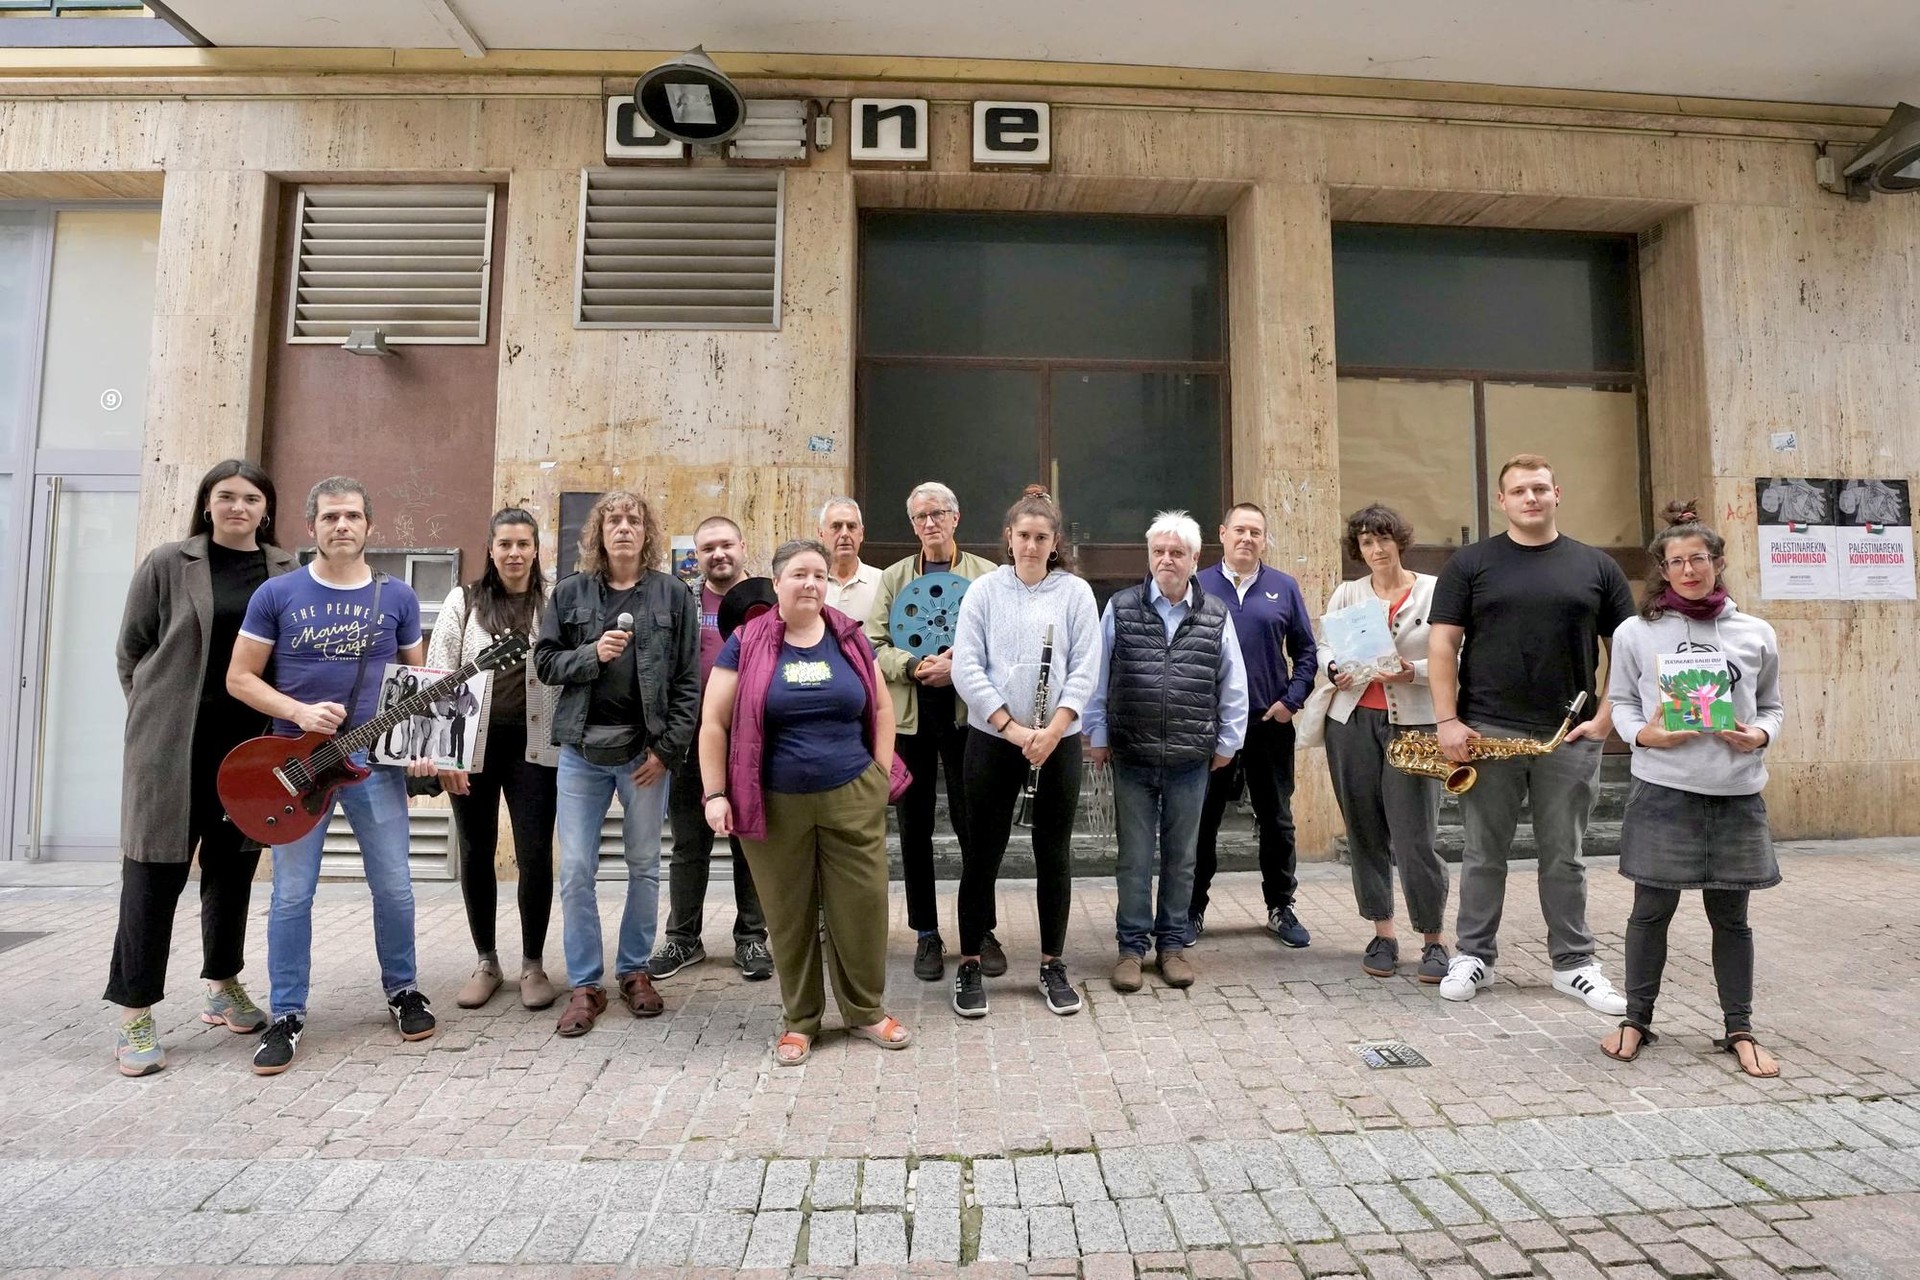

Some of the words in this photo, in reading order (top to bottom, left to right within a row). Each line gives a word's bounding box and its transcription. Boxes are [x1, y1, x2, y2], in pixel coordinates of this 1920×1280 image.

[1771, 542, 1827, 553] PALESTINAREKIN
[1848, 543, 1904, 553] PALESTINAREKIN
[1771, 553, 1827, 564] KONPROMISOA
[1849, 553, 1905, 564] KONPROMISOA
[291, 605, 316, 622] THE
[326, 603, 384, 625] PEAWES
[291, 620, 368, 649] Moving
